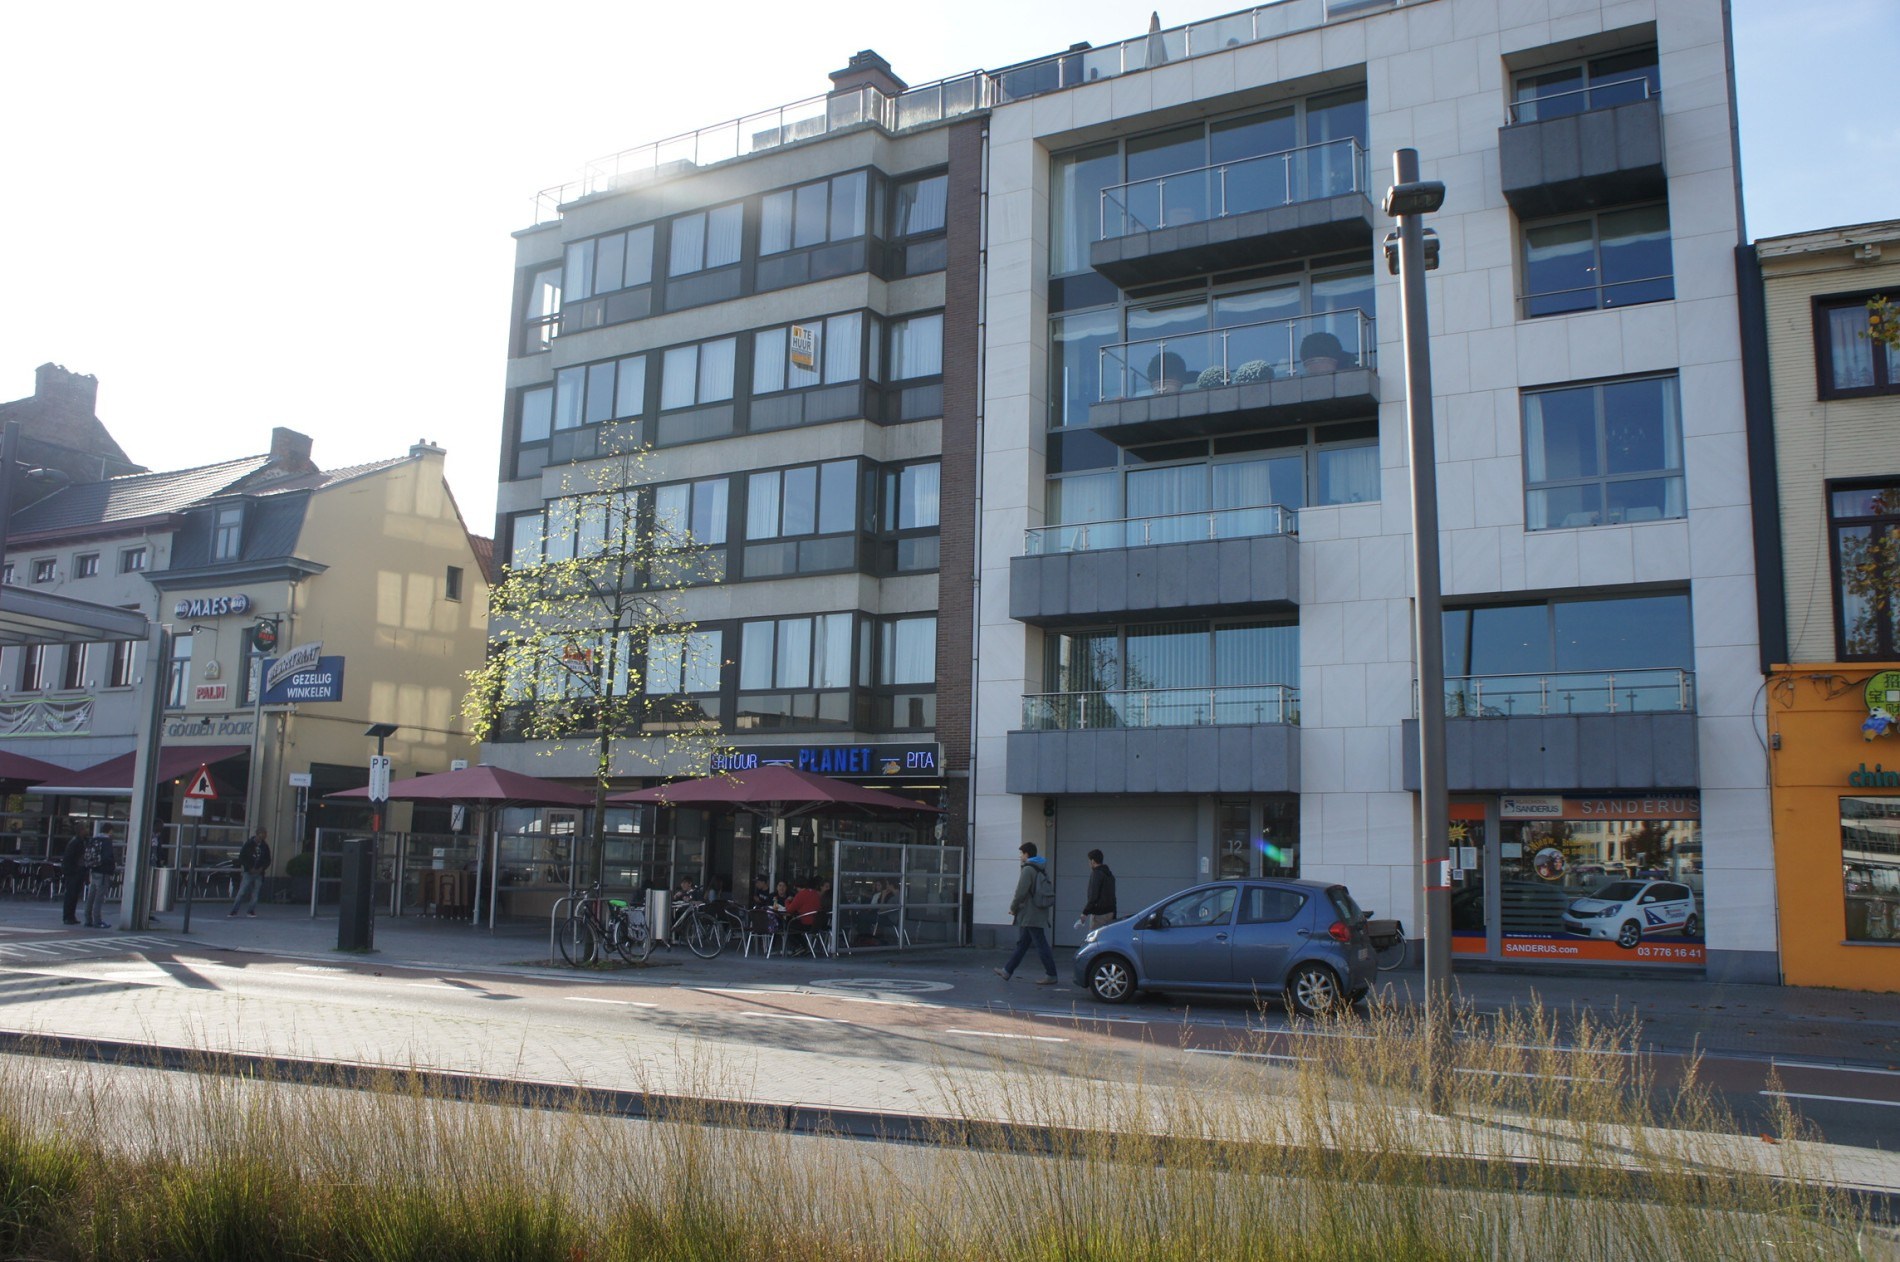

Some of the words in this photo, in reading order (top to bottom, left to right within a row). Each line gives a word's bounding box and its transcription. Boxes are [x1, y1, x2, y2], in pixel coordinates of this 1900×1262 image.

[803, 329, 812, 340] TE
[792, 337, 812, 350] HUUR
[188, 597, 228, 617] MAES
[292, 673, 332, 685] GEZELLIG
[196, 686, 226, 700] PALM
[287, 687, 331, 698] WINKELEN
[168, 722, 215, 737] GOUDEN
[372, 758, 379, 769] P
[381, 758, 389, 769] P
[800, 748, 871, 772] PLANET
[906, 752, 935, 768] PITA
[1849, 763, 1900, 787] chin
[1515, 805, 1559, 813] SANDERUS
[1582, 800, 1700, 814] SANDERUS
[1228, 840, 1242, 854] 12
[1505, 943, 1579, 954] SANDERUS.com
[1637, 947, 1650, 956] 03
[1653, 947, 1671, 957] 776
[1674, 948, 1687, 957] 16
[1688, 948, 1701, 958] 41
